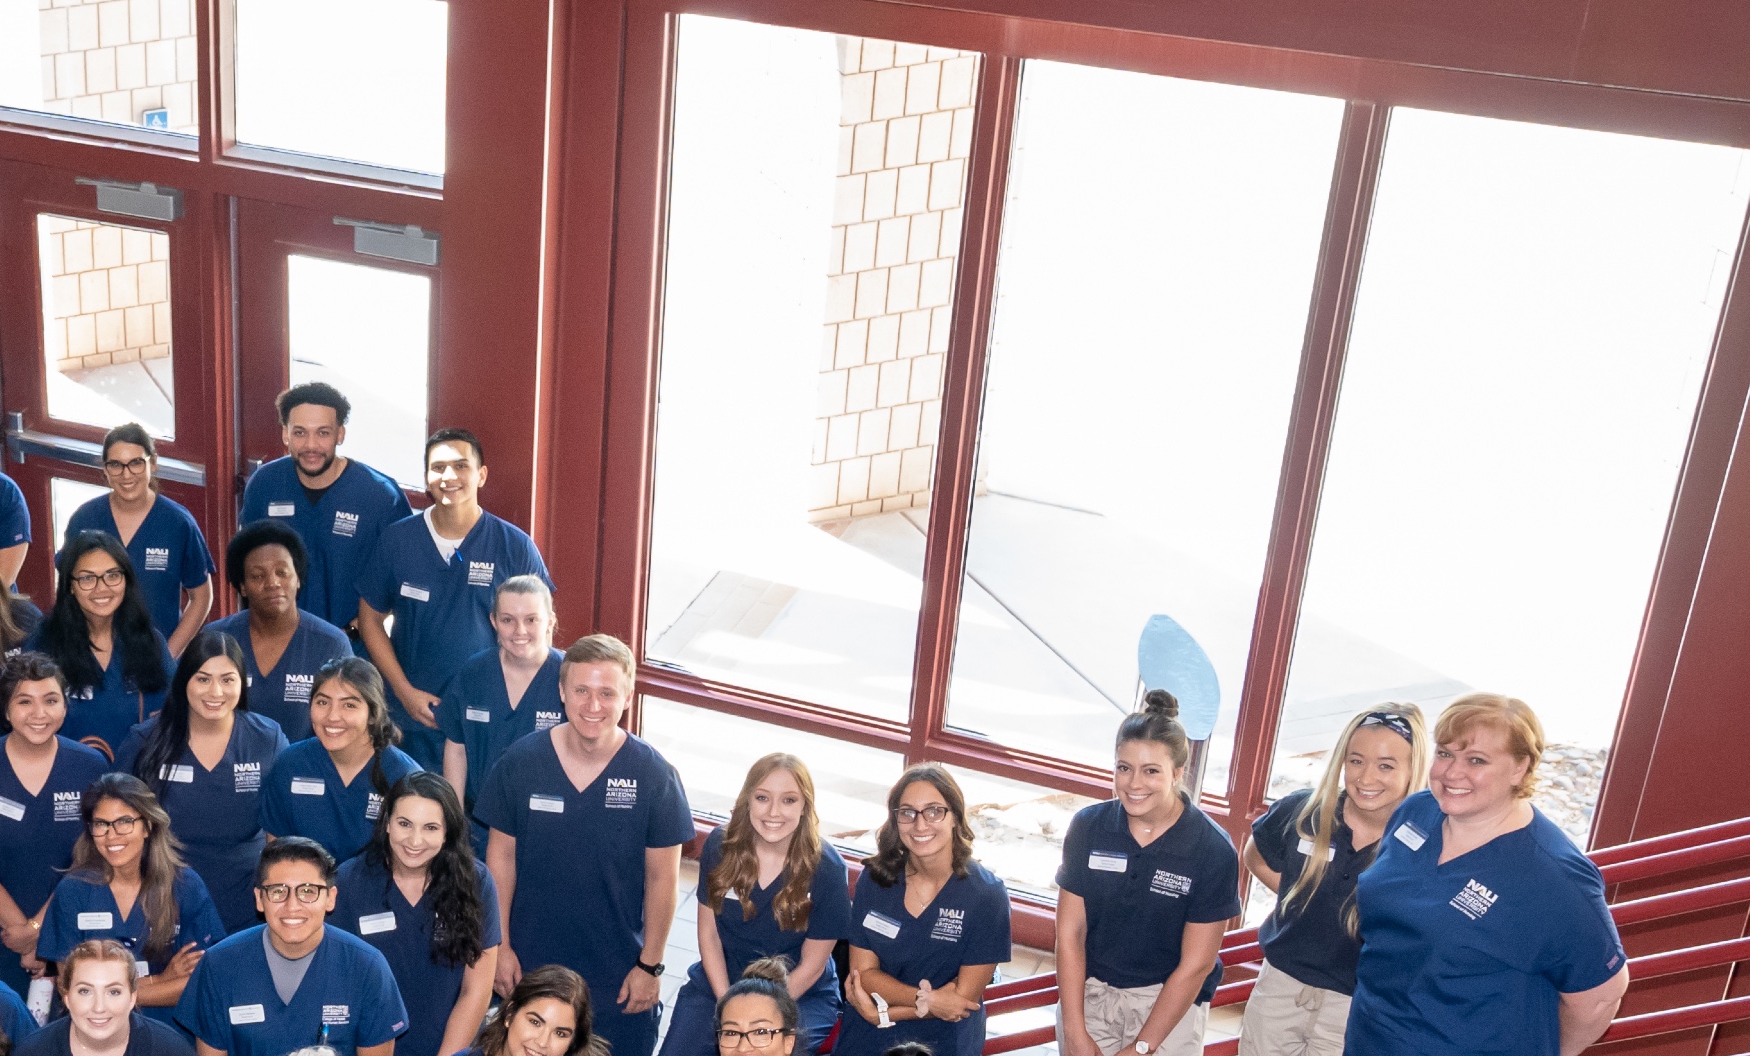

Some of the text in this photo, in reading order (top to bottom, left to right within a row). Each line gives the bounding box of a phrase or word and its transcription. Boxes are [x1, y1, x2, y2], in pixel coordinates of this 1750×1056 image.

[336, 511, 359, 521] NAU
[470, 561, 494, 570] NAU
[286, 674, 314, 683] NAU
[536, 711, 561, 719] NAU
[234, 762, 260, 772] NAU
[608, 778, 637, 787] NAU
[54, 791, 80, 801] NAU
[1154, 875, 1182, 886] ARIZONA
[1156, 869, 1192, 883] NORTHERN
[1467, 879, 1499, 903] NAU
[1459, 891, 1488, 912] ARIZONA
[1463, 887, 1492, 907] NORTHERN
[1456, 895, 1485, 915] UNIVERSITY
[939, 908, 964, 919] NAU
[935, 922, 962, 930] ARIZONA
